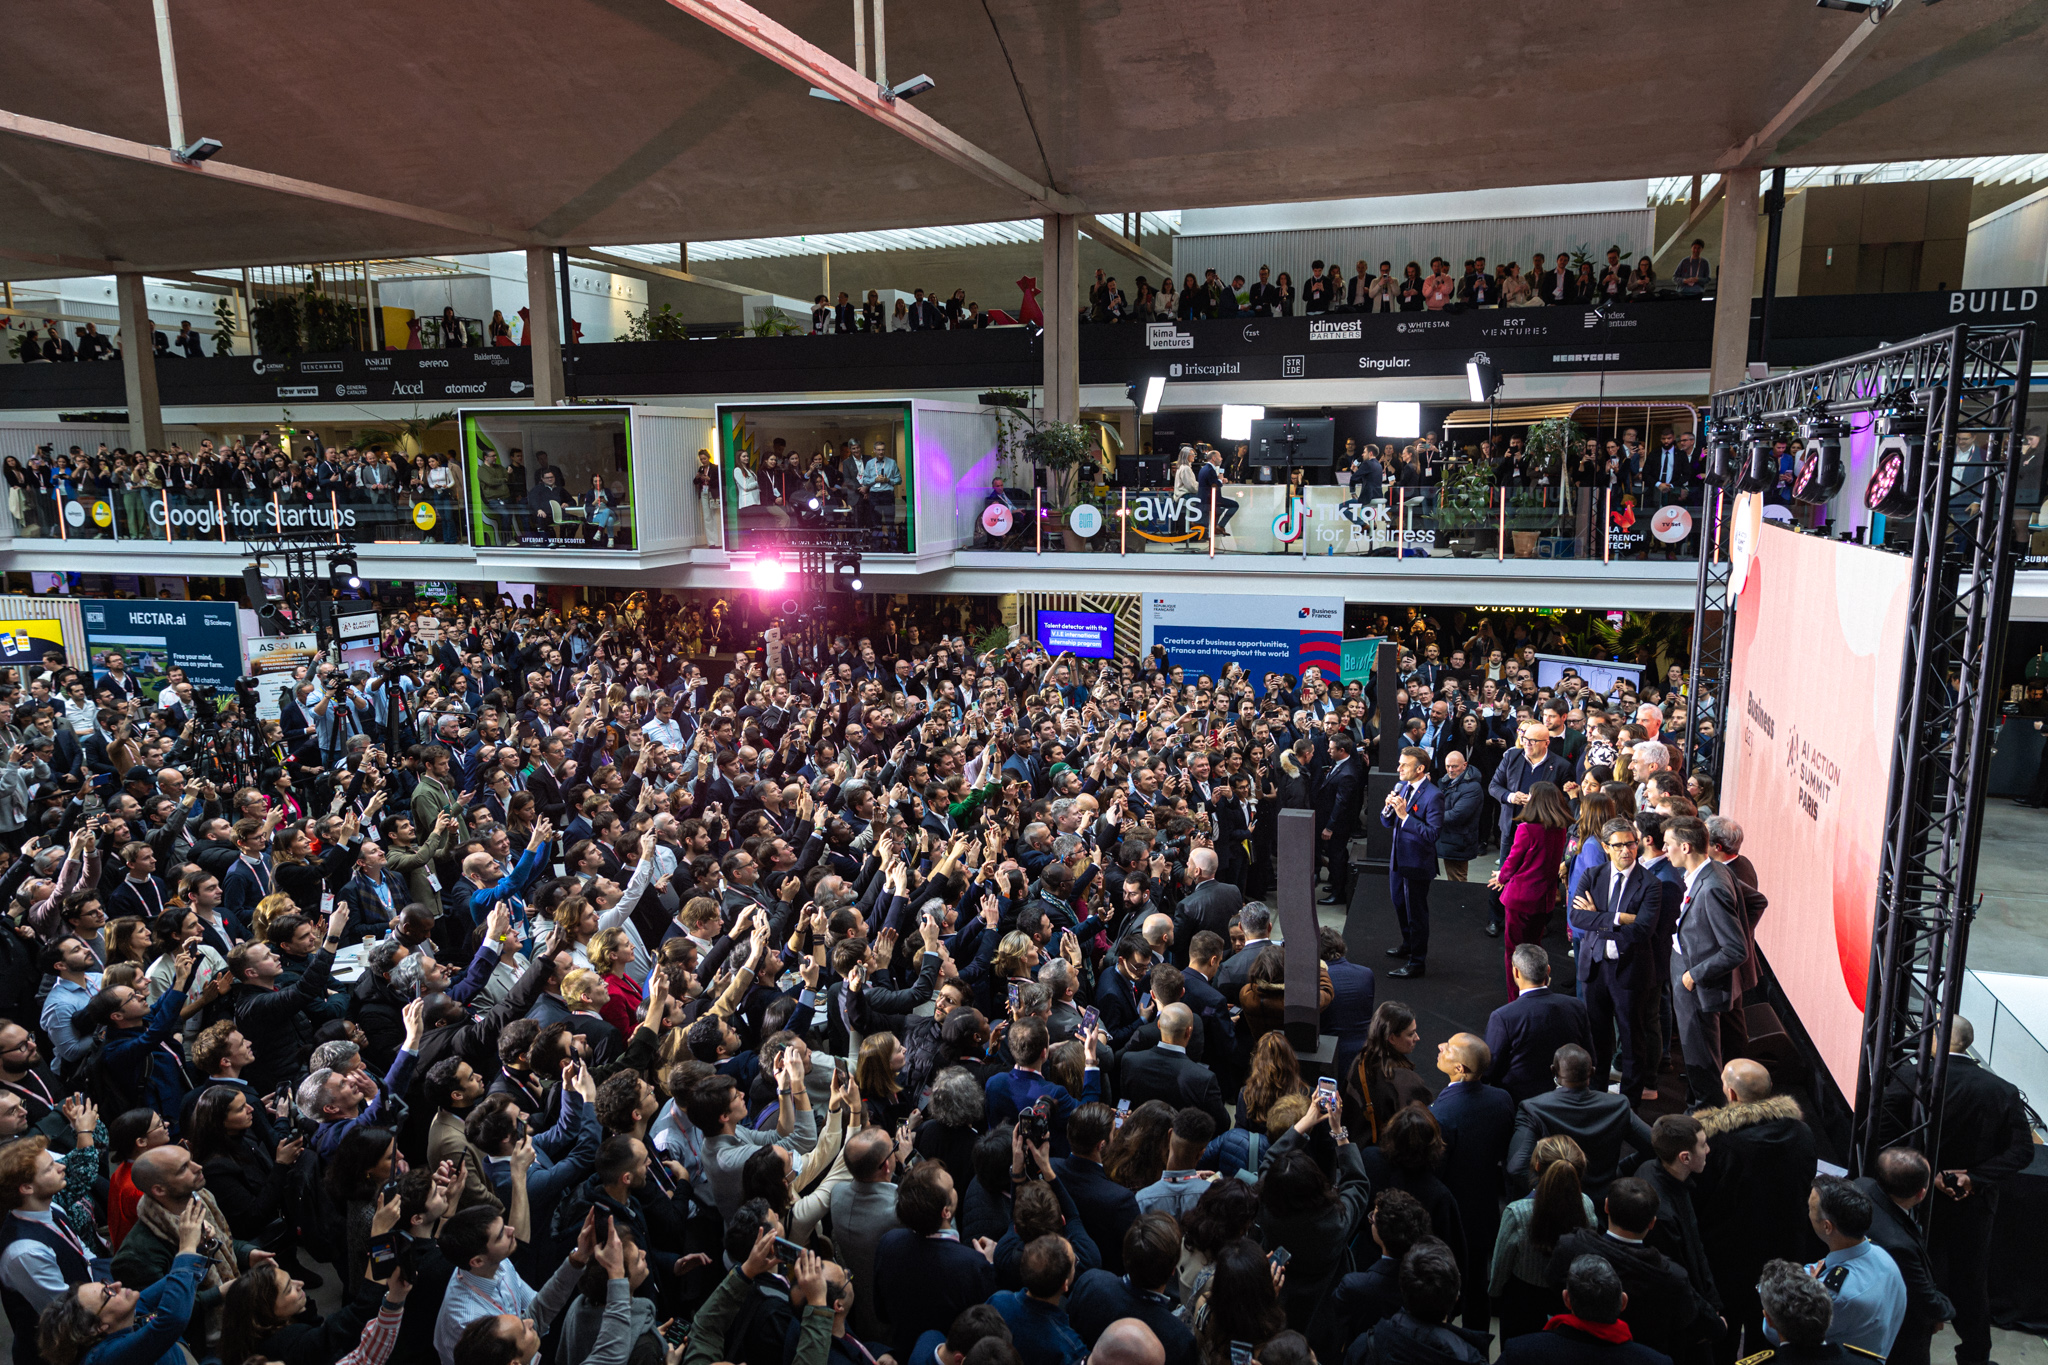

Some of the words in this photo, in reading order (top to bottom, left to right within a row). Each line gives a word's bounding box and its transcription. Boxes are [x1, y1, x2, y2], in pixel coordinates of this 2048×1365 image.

[1949, 289, 2038, 313] BUILD
[1309, 319, 1362, 332] idinvest
[1408, 321, 1432, 329] WHITE
[1503, 318, 1526, 326] EQT
[1608, 320, 1638, 328] entures
[1152, 329, 1174, 338] kima
[1311, 331, 1361, 339] PARTNERS
[1481, 327, 1548, 336] VENTURES
[1152, 339, 1191, 347] ventures
[1286, 358, 1301, 366] STR
[1552, 353, 1620, 362] HEARTCORE
[418, 360, 449, 368] serena
[1185, 361, 1241, 376] iriscapital
[1286, 366, 1301, 374] IDE
[1359, 357, 1411, 371] Singular.
[392, 380, 424, 395] Accel
[1134, 496, 1202, 522] aws
[1316, 503, 1391, 522] TikTok
[150, 499, 228, 534] Google
[231, 502, 261, 527] for
[264, 502, 357, 530] Startups
[1316, 524, 1343, 542] for
[1350, 524, 1435, 542] Business
[129, 611, 187, 626] HECTAR.ai
[259, 641, 307, 652] ASSOLIA
[1163, 637, 1195, 645] Creators
[1237, 641, 1289, 649] opportunities,
[1212, 648, 1253, 657] throughout
[1747, 689, 1775, 740] Business
[1801, 740, 1811, 761] AI
[1810, 748, 1842, 787] ACTION
[1800, 762, 1831, 804] SUMMIT
[1798, 786, 1819, 822] PARIS
